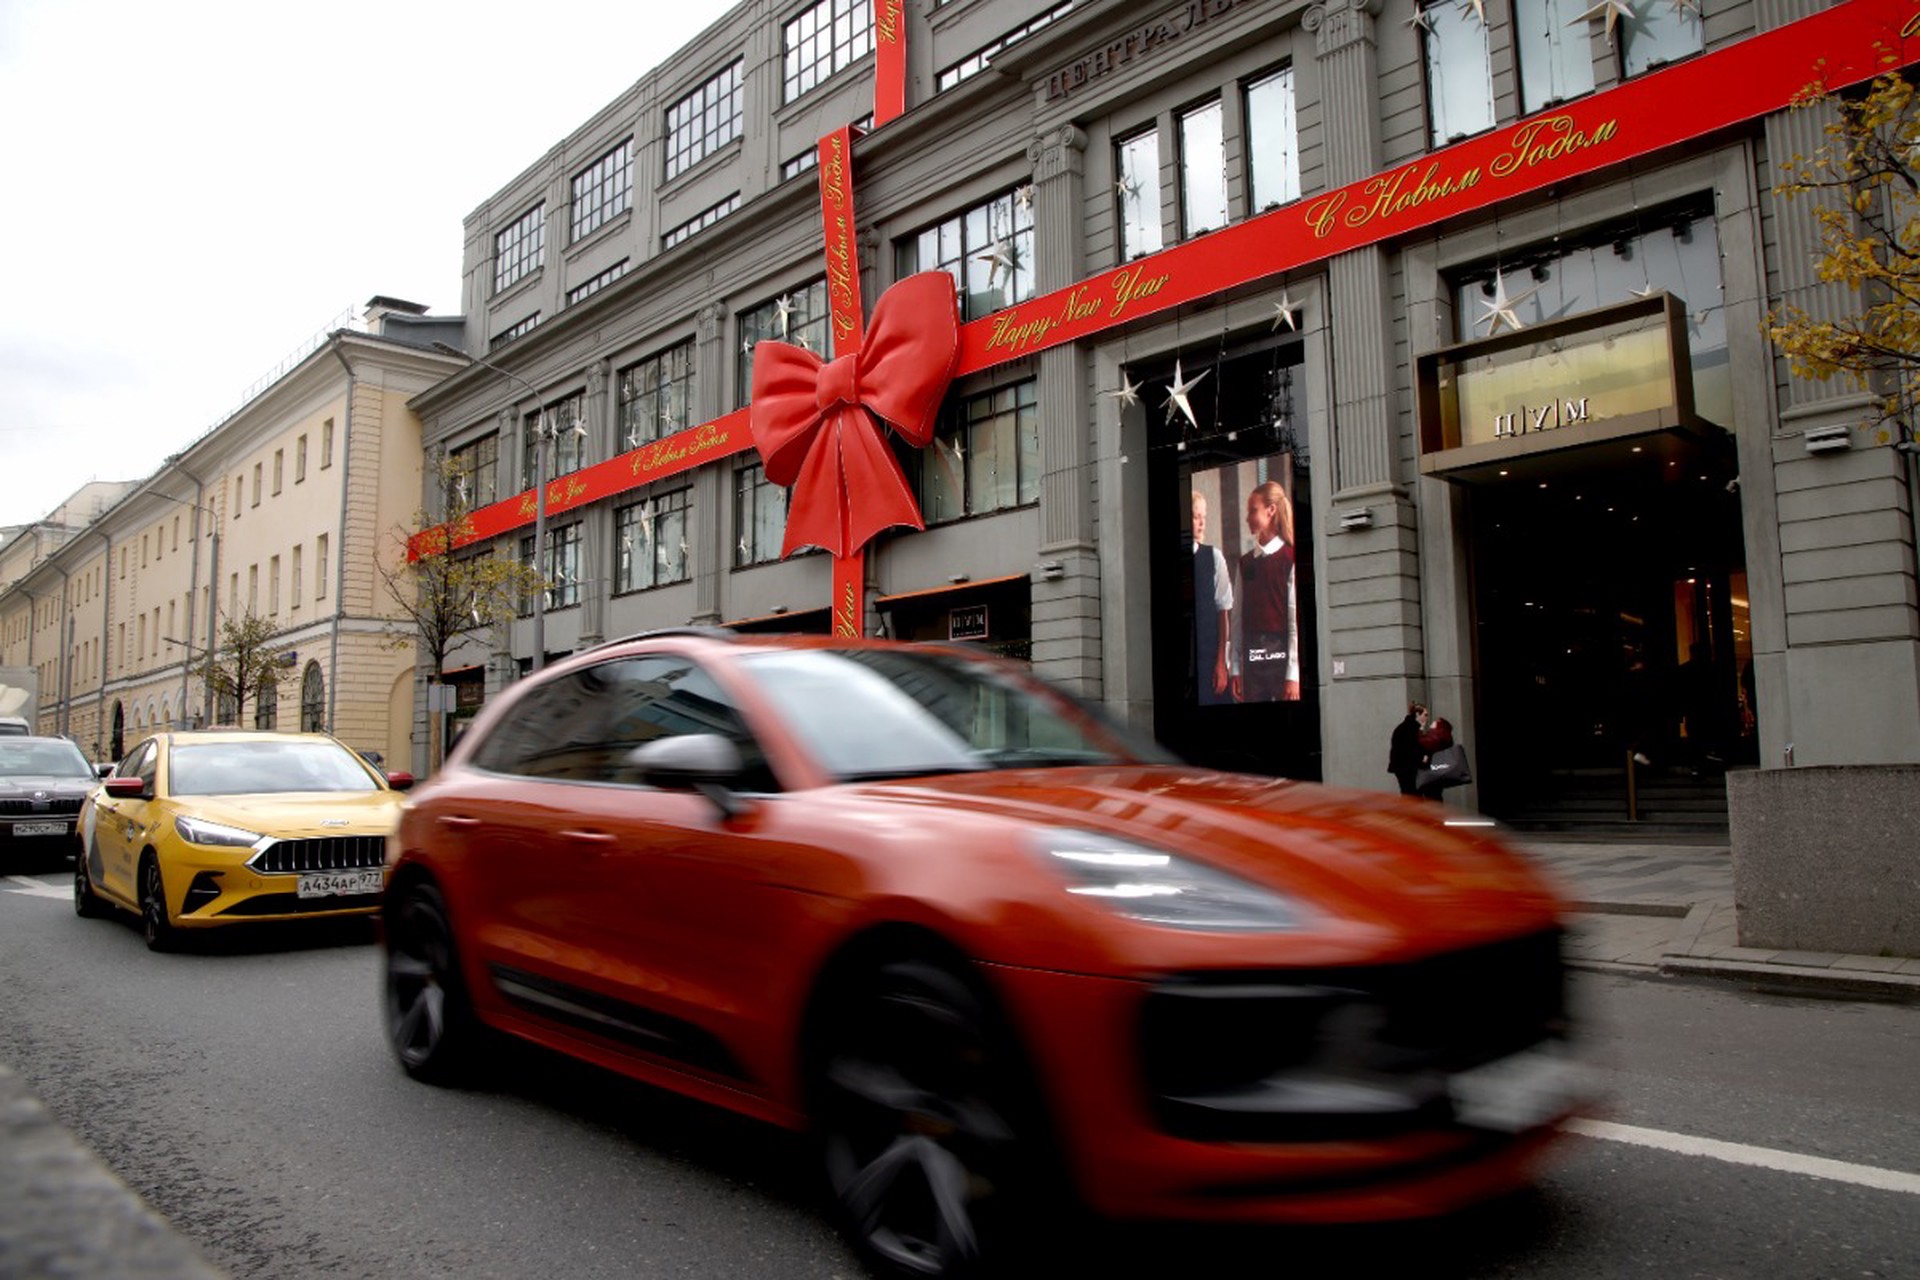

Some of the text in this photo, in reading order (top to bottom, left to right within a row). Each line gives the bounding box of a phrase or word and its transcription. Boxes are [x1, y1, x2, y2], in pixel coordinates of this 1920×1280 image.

[825, 136, 845, 210] Годом
[1305, 115, 1617, 238] С Новым Годом
[830, 215, 852, 308] Новым
[986, 265, 1169, 352] Happy New Year
